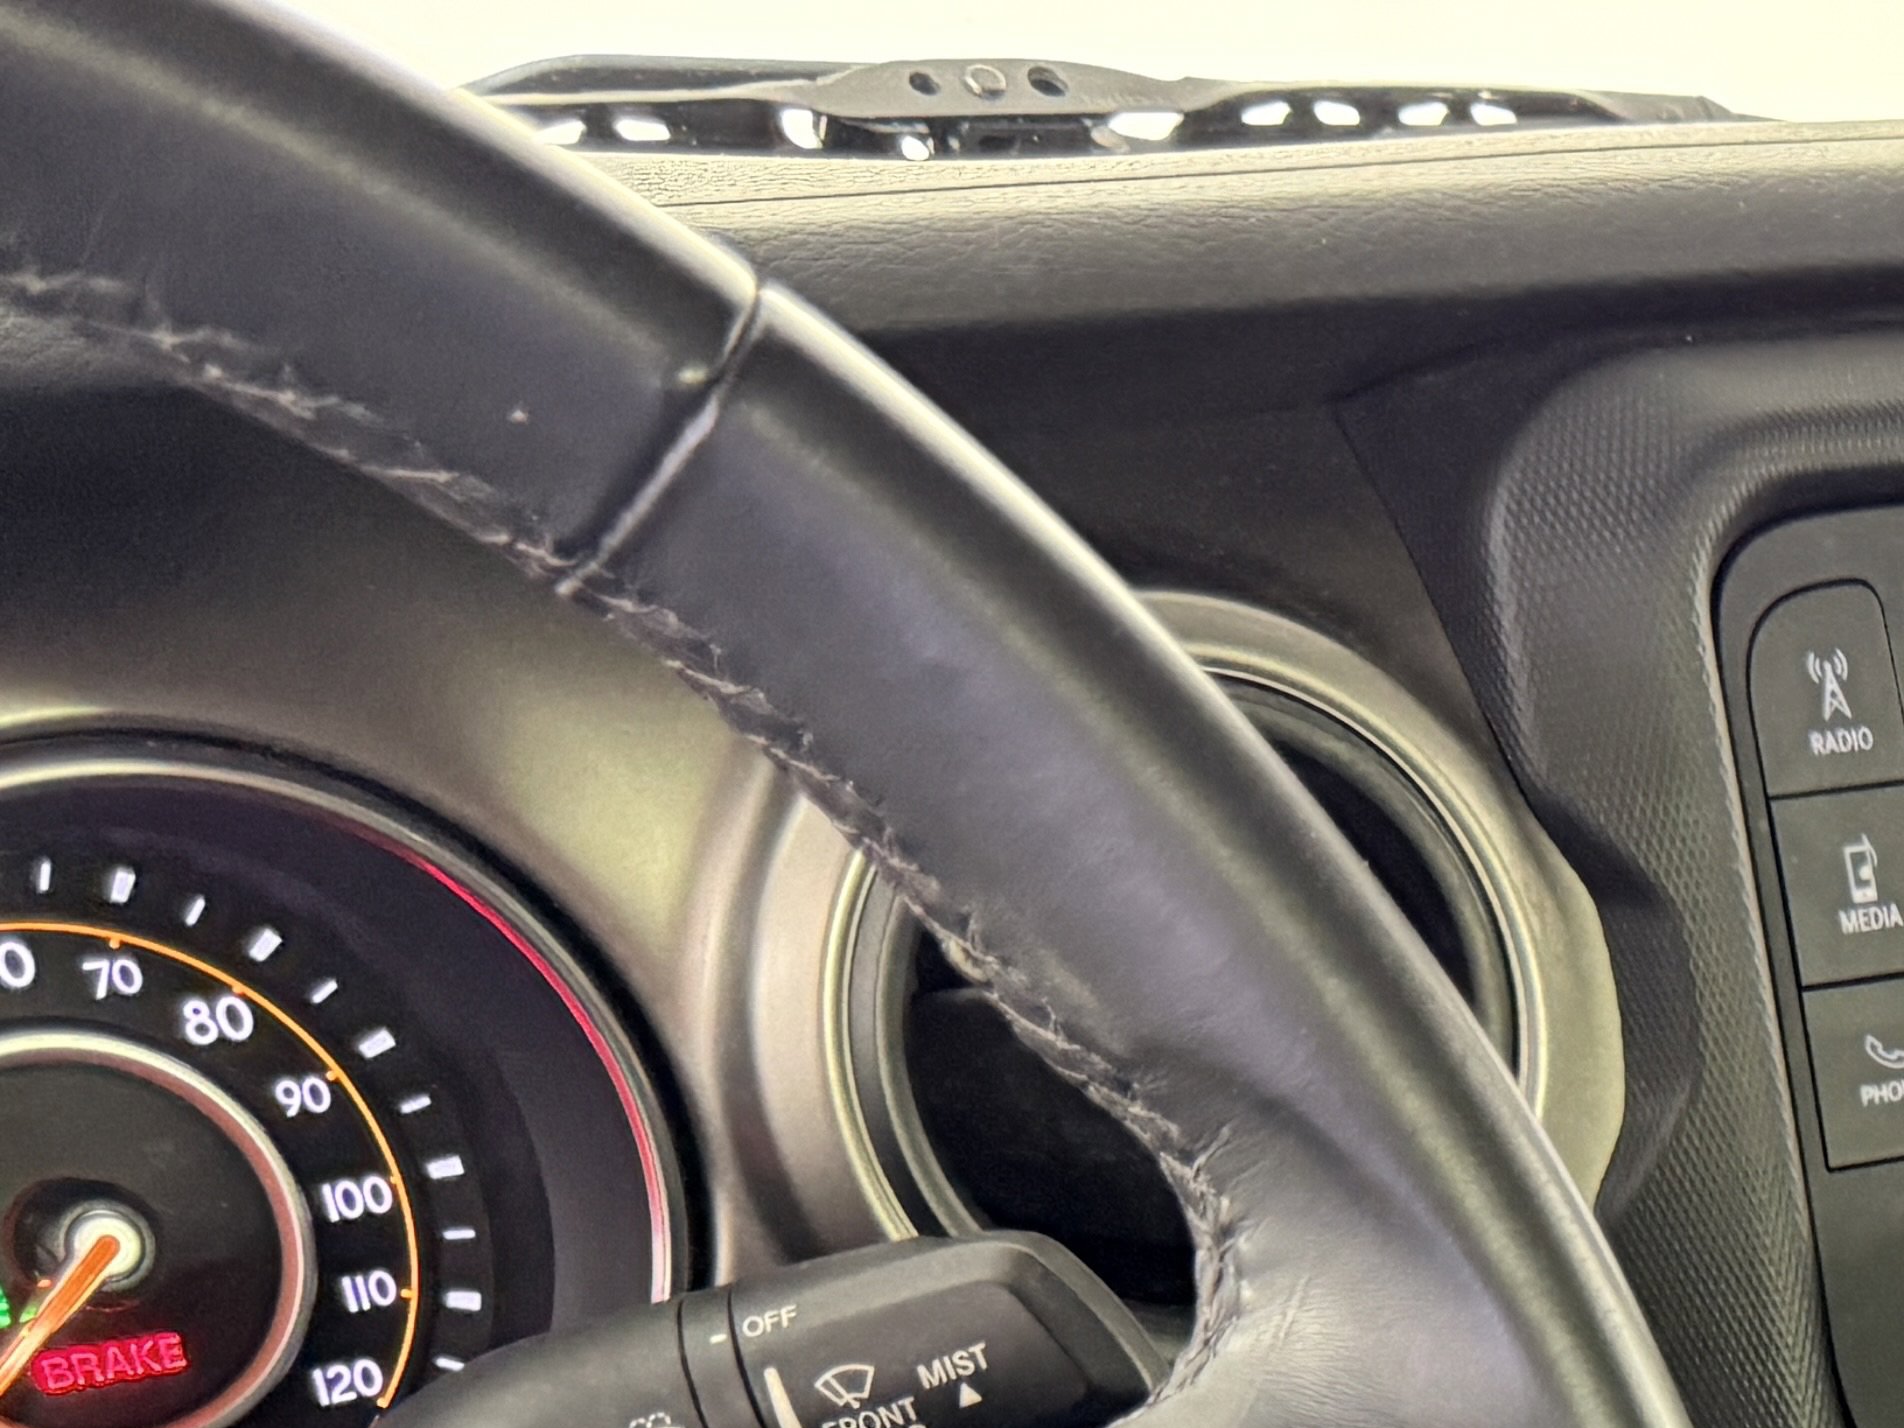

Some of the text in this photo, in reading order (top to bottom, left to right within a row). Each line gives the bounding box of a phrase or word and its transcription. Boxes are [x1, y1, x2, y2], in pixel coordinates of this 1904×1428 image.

[1810, 727, 1874, 755] RADIO
[1839, 904, 1904, 935] MEDIA
[82, 958, 143, 1000] 70
[183, 994, 253, 1045] 80
[275, 1076, 331, 1117] 90
[322, 1176, 393, 1223] 100
[341, 1270, 397, 1313] 110
[742, 1305, 797, 1339] OFF
[40, 1335, 188, 1391] BRAKE
[313, 1359, 384, 1406] 120
[917, 1342, 989, 1391] MIST
